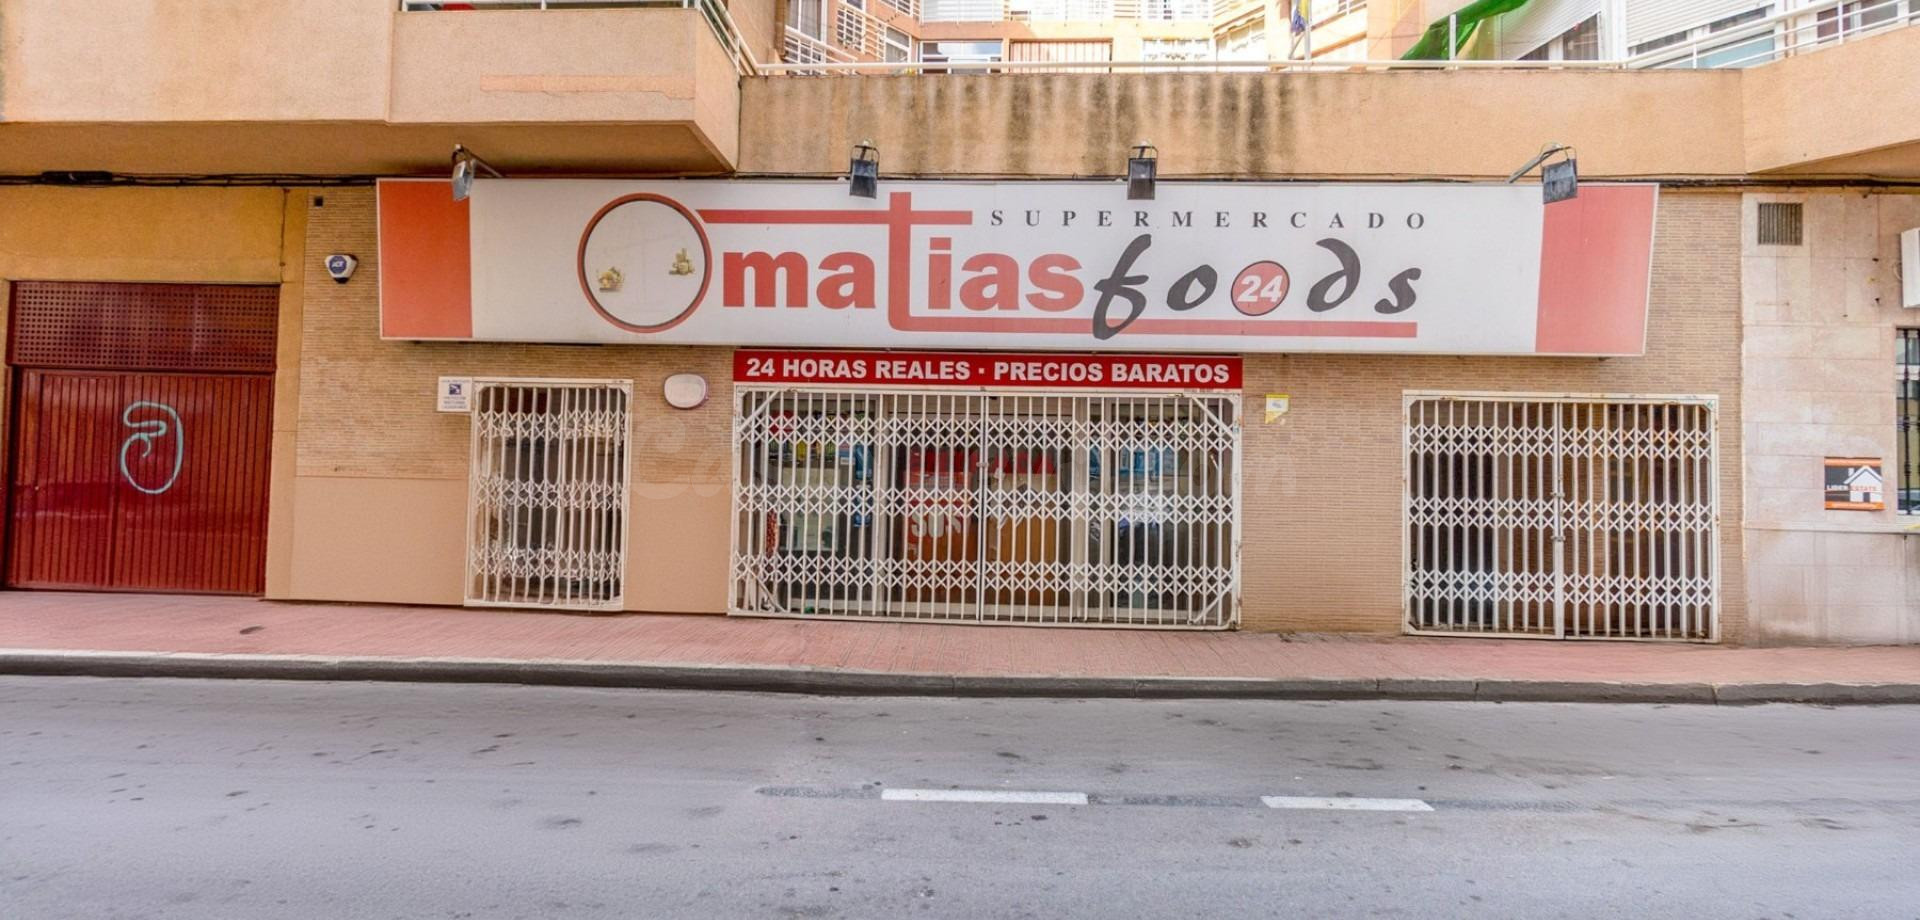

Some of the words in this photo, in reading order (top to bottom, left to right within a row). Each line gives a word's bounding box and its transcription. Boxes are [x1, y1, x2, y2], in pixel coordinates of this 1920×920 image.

[990, 208, 1427, 231] SUPERMERCADO
[1237, 275, 1283, 302] 24
[746, 358, 775, 377] 24
[783, 359, 867, 379] HORAS
[875, 360, 971, 380] REALES
[994, 361, 1103, 382] PRECIOS
[1111, 363, 1230, 383] BARATOS
